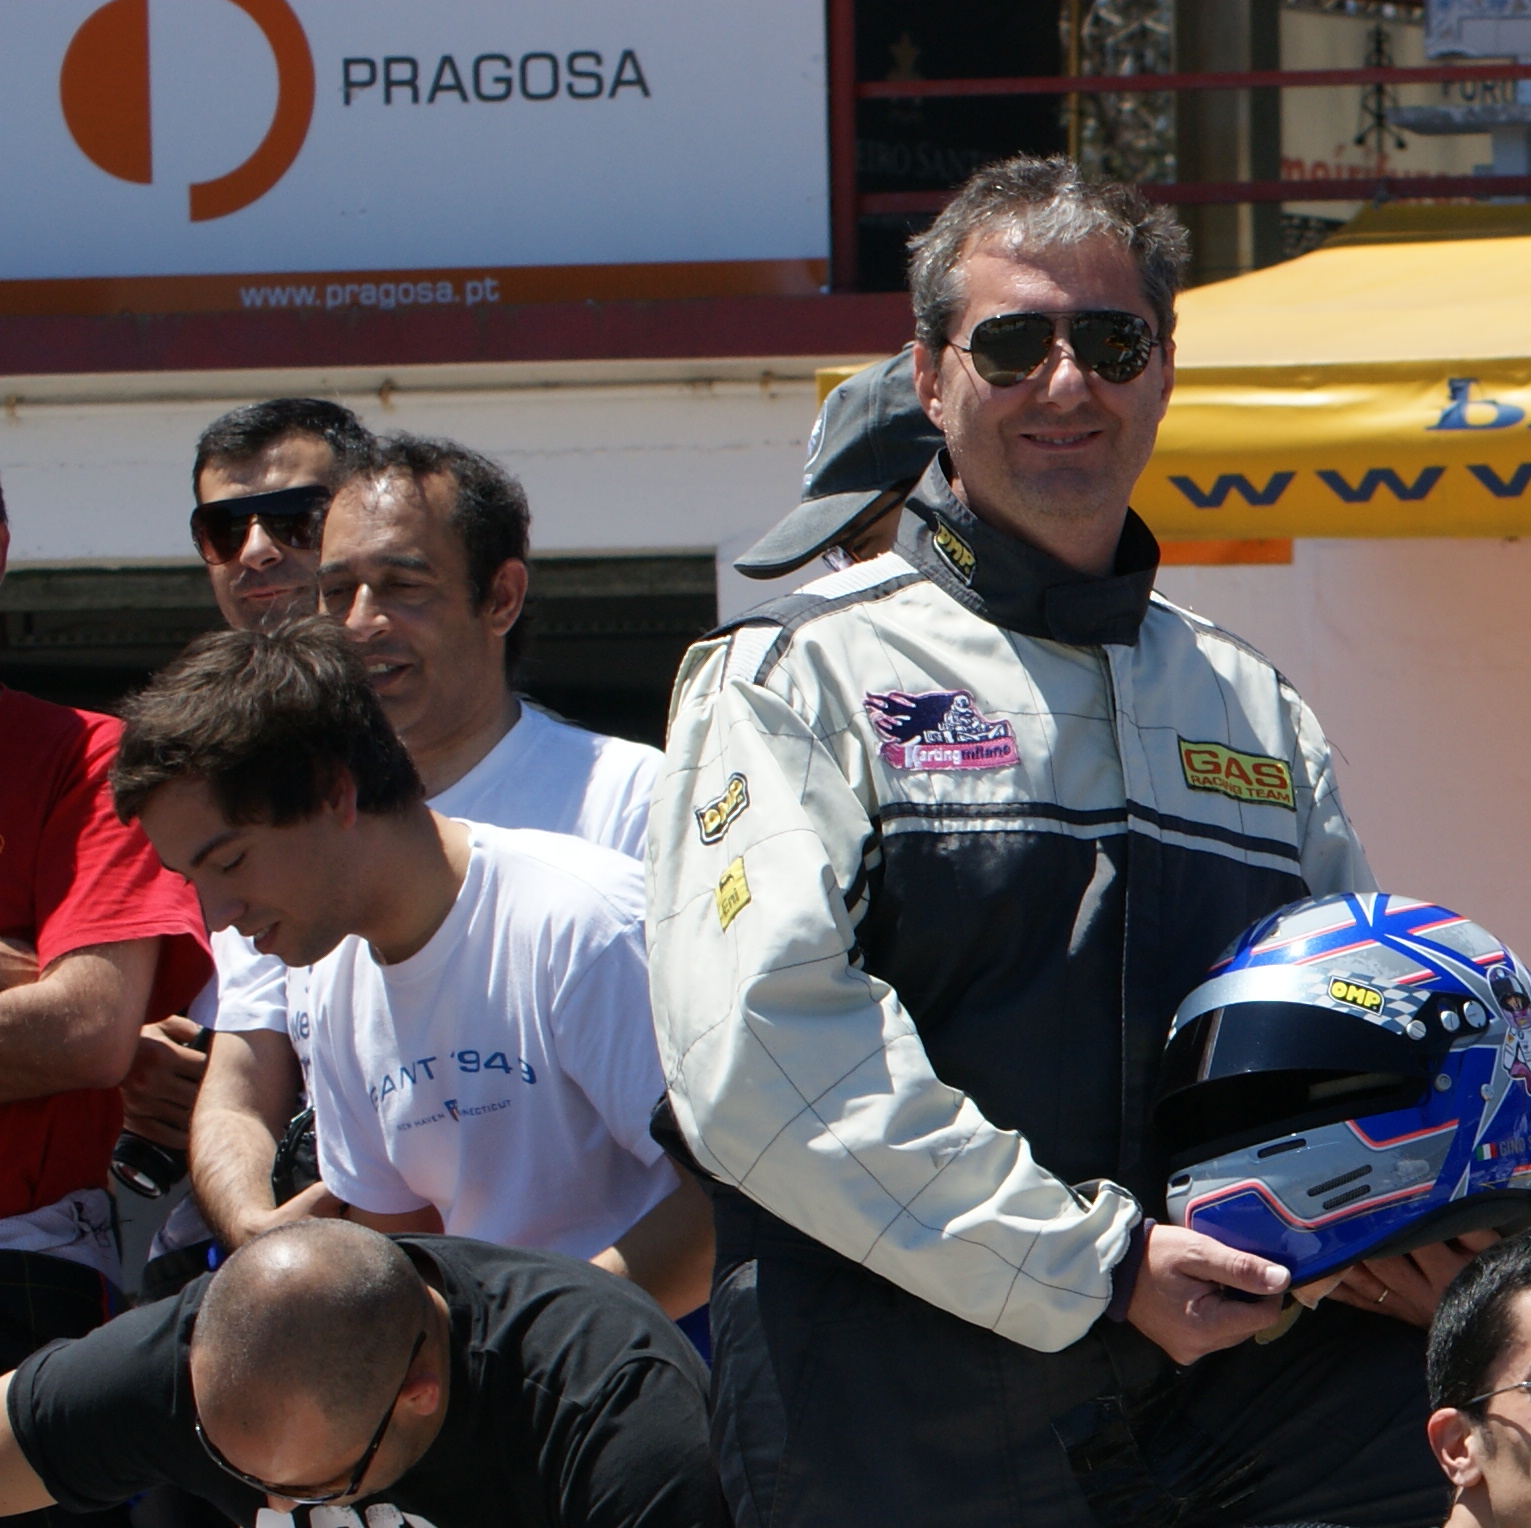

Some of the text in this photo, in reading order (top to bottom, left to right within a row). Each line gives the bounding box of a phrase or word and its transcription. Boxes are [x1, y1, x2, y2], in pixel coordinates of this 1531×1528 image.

[343, 50, 651, 106] PRAGOSA
[240, 275, 501, 310] www.pragosa.pt
[1184, 749, 1288, 789] GAS
[1190, 775, 1290, 803] RACING TEAM
[1331, 981, 1382, 1008] OMP
